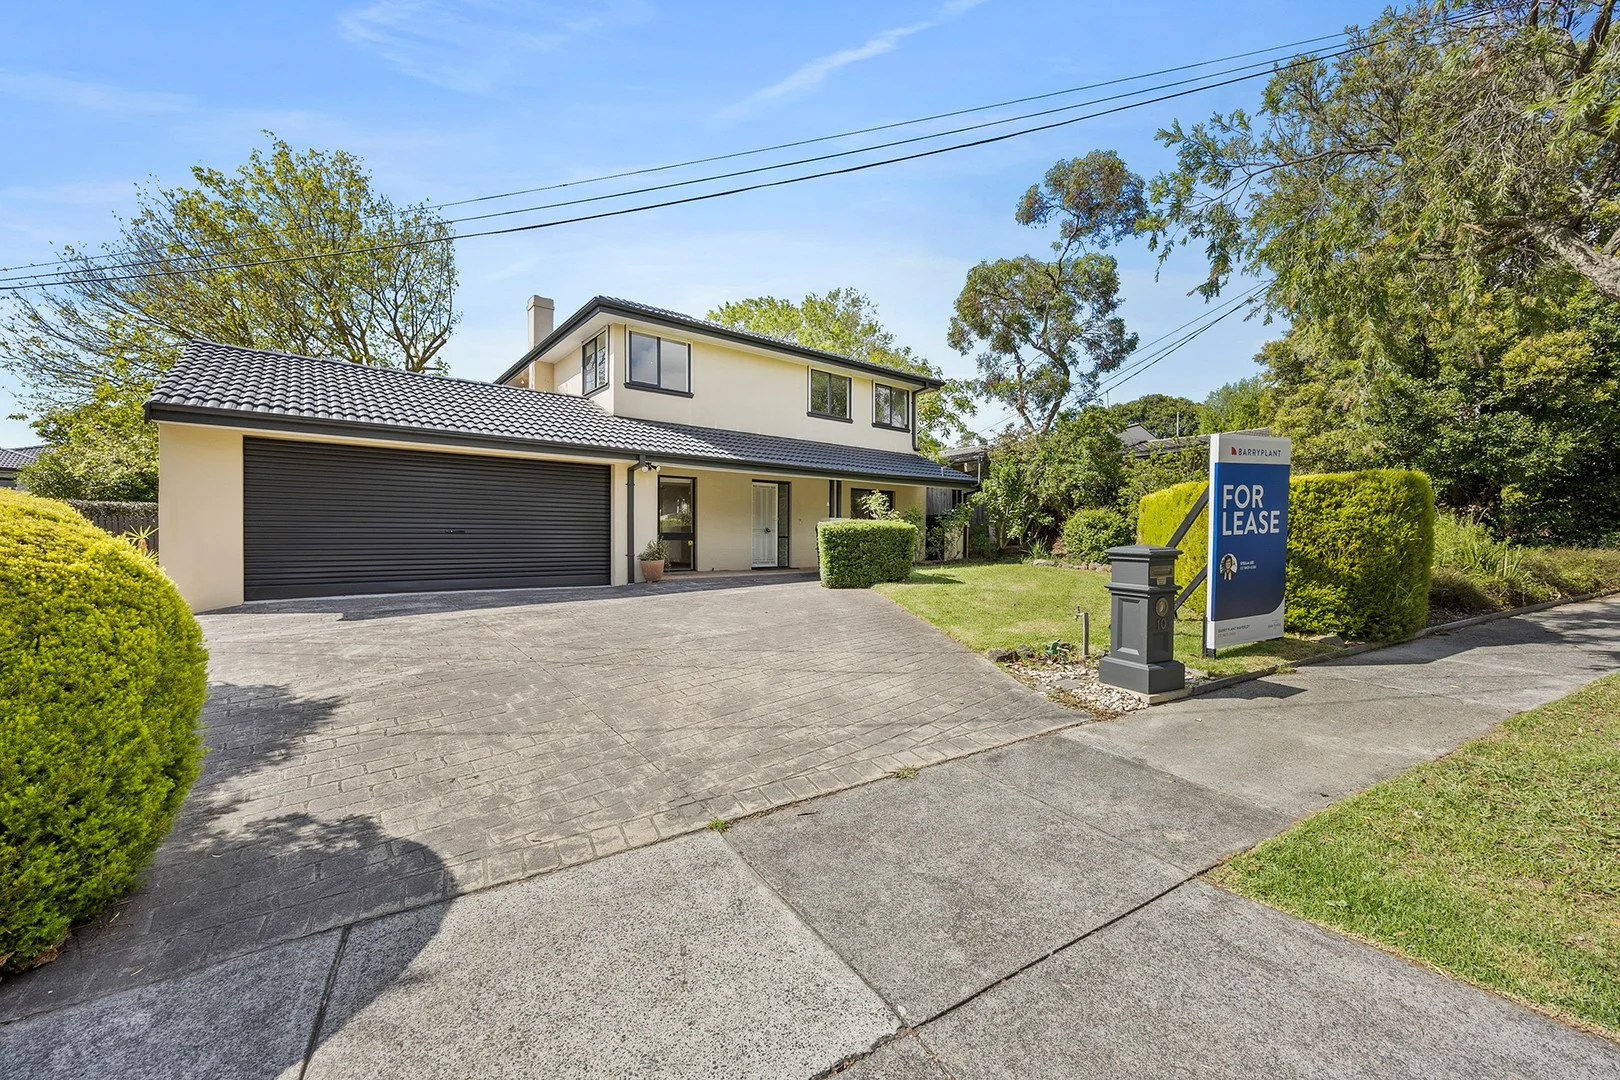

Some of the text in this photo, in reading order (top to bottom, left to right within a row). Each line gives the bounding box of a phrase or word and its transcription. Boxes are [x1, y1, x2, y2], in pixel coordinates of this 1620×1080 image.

[1238, 447, 1281, 457] BARRYPLANT
[1223, 484, 1264, 509] FOR
[1222, 510, 1280, 536] LEASE
[1157, 618, 1167, 631] 10
